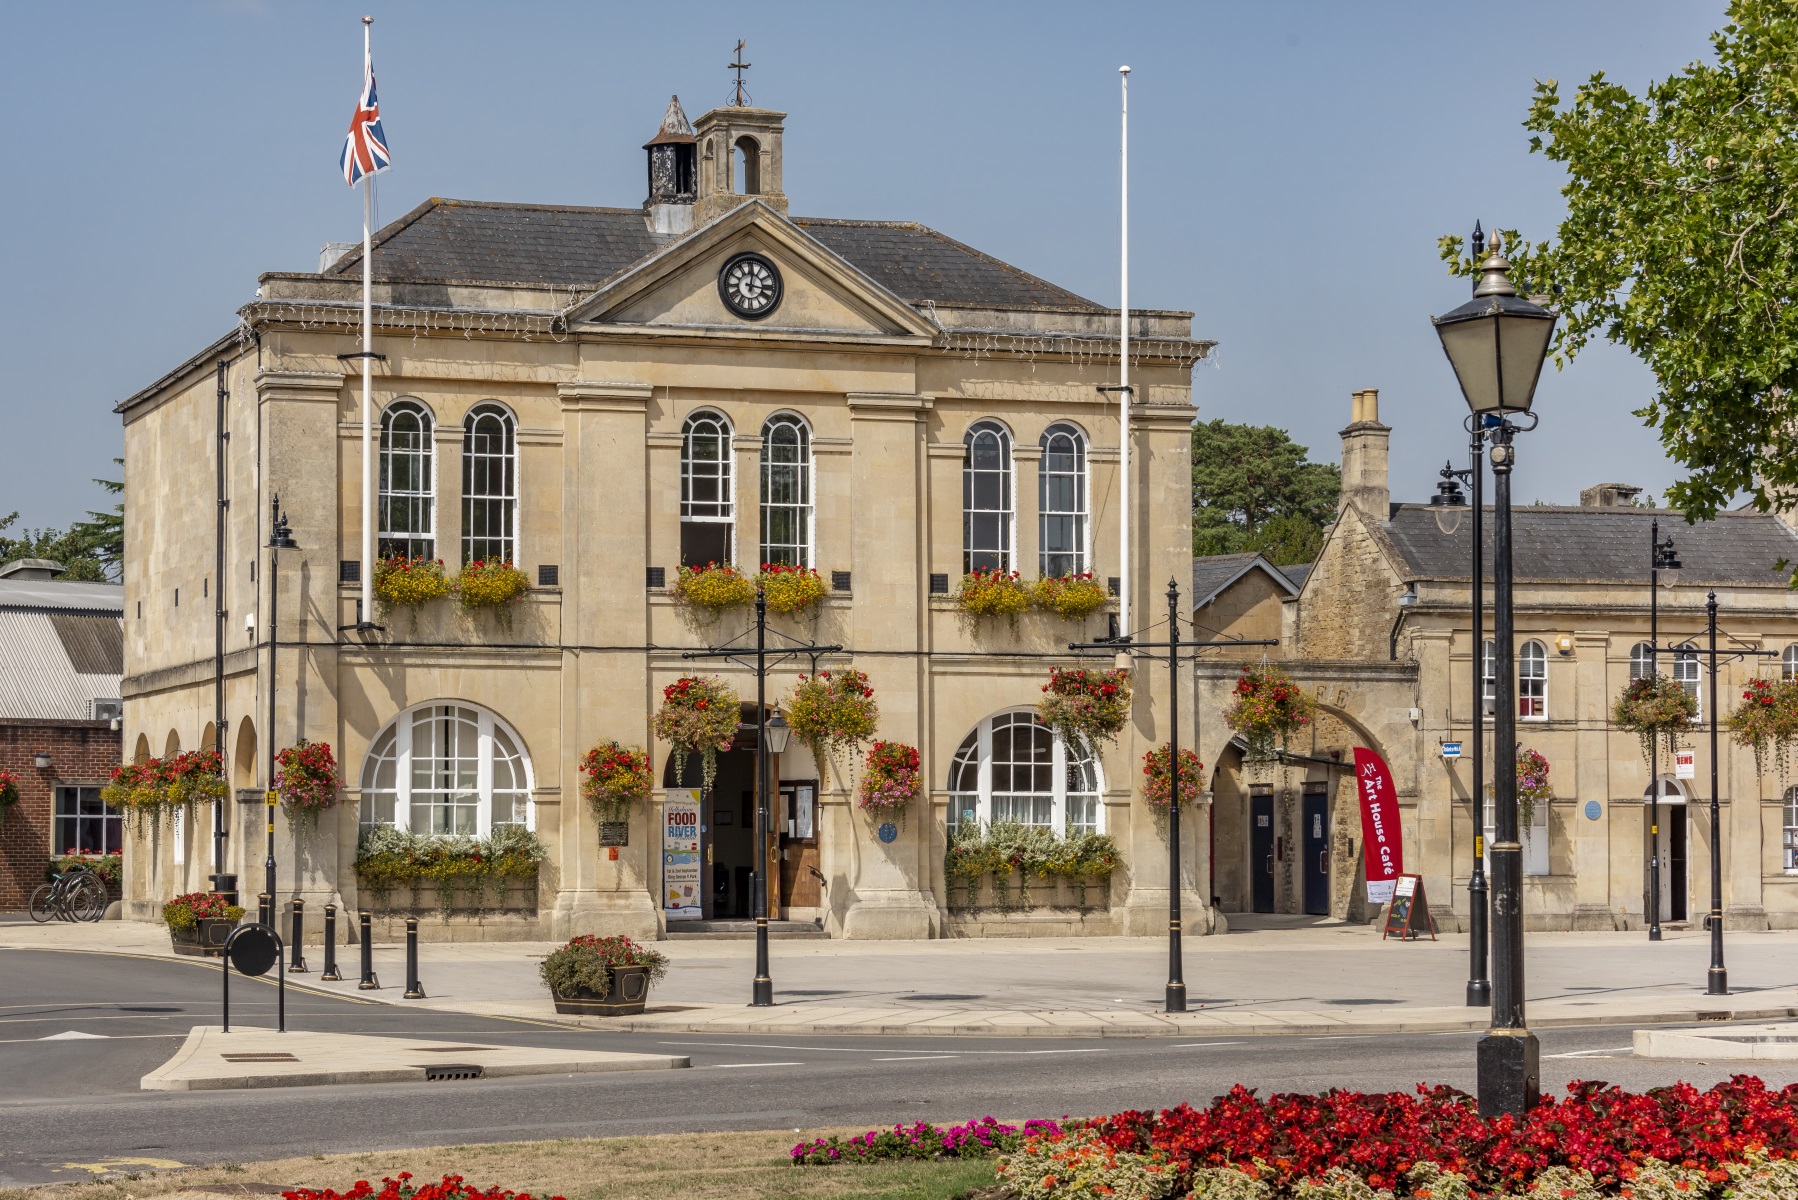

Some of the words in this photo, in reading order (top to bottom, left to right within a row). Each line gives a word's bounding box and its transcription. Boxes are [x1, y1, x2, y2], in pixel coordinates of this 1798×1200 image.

[1677, 756, 1693, 765] NEWS
[1364, 779, 1378, 801] Art
[1375, 776, 1383, 790] The
[668, 812, 697, 826] FOOD
[1370, 802, 1386, 843] House
[668, 826, 697, 838] RIVER
[1380, 846, 1395, 875] Café
